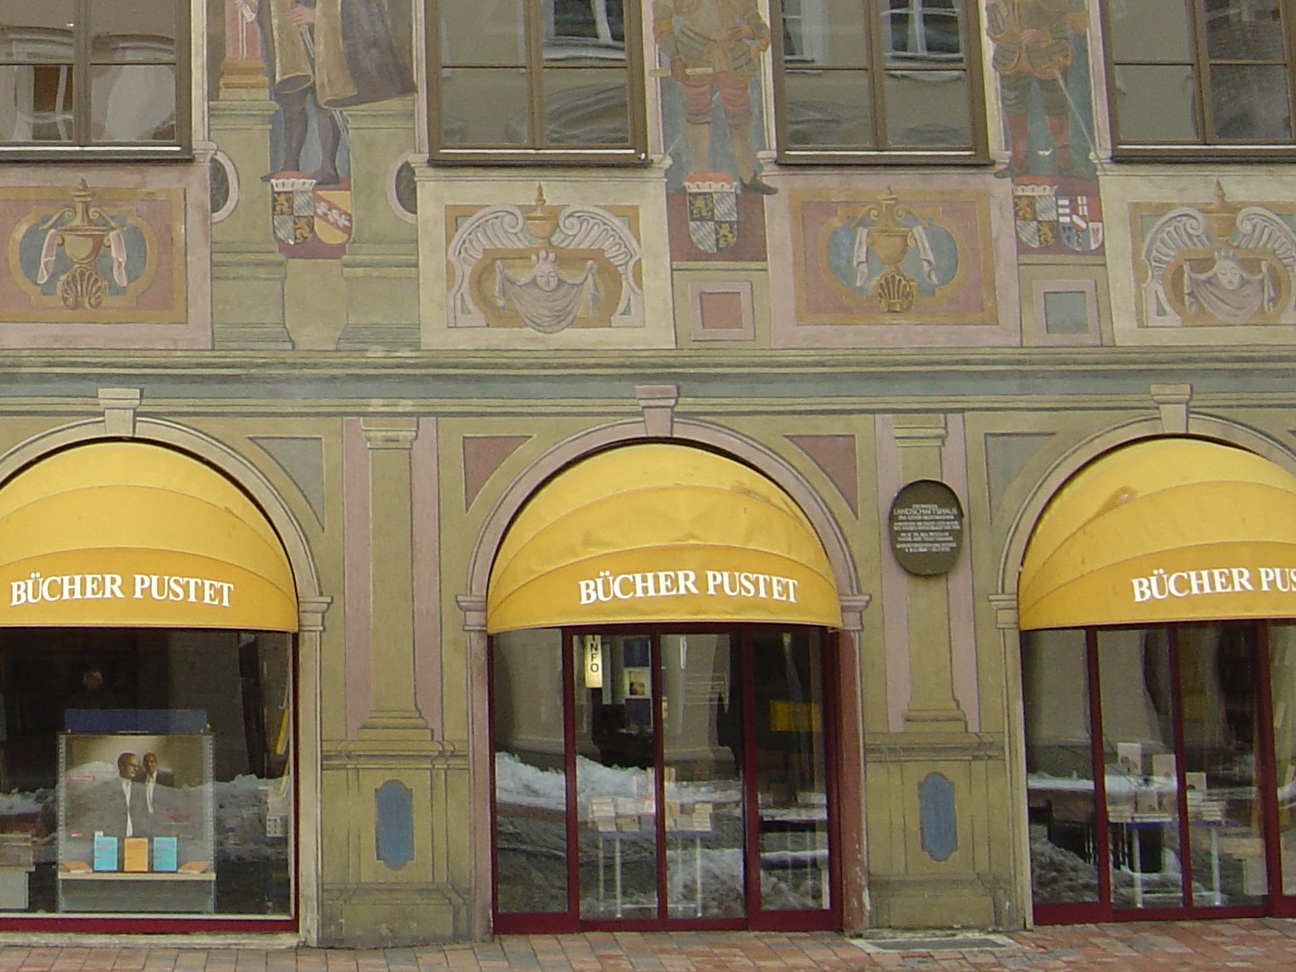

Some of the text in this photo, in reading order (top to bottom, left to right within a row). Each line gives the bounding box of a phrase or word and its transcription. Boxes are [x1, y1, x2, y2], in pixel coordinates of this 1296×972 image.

[10, 572, 234, 608] BÜCHER PUSTET
[578, 570, 799, 605] BÜCHER PUSTET
[1131, 568, 1254, 603] BÜCHER
